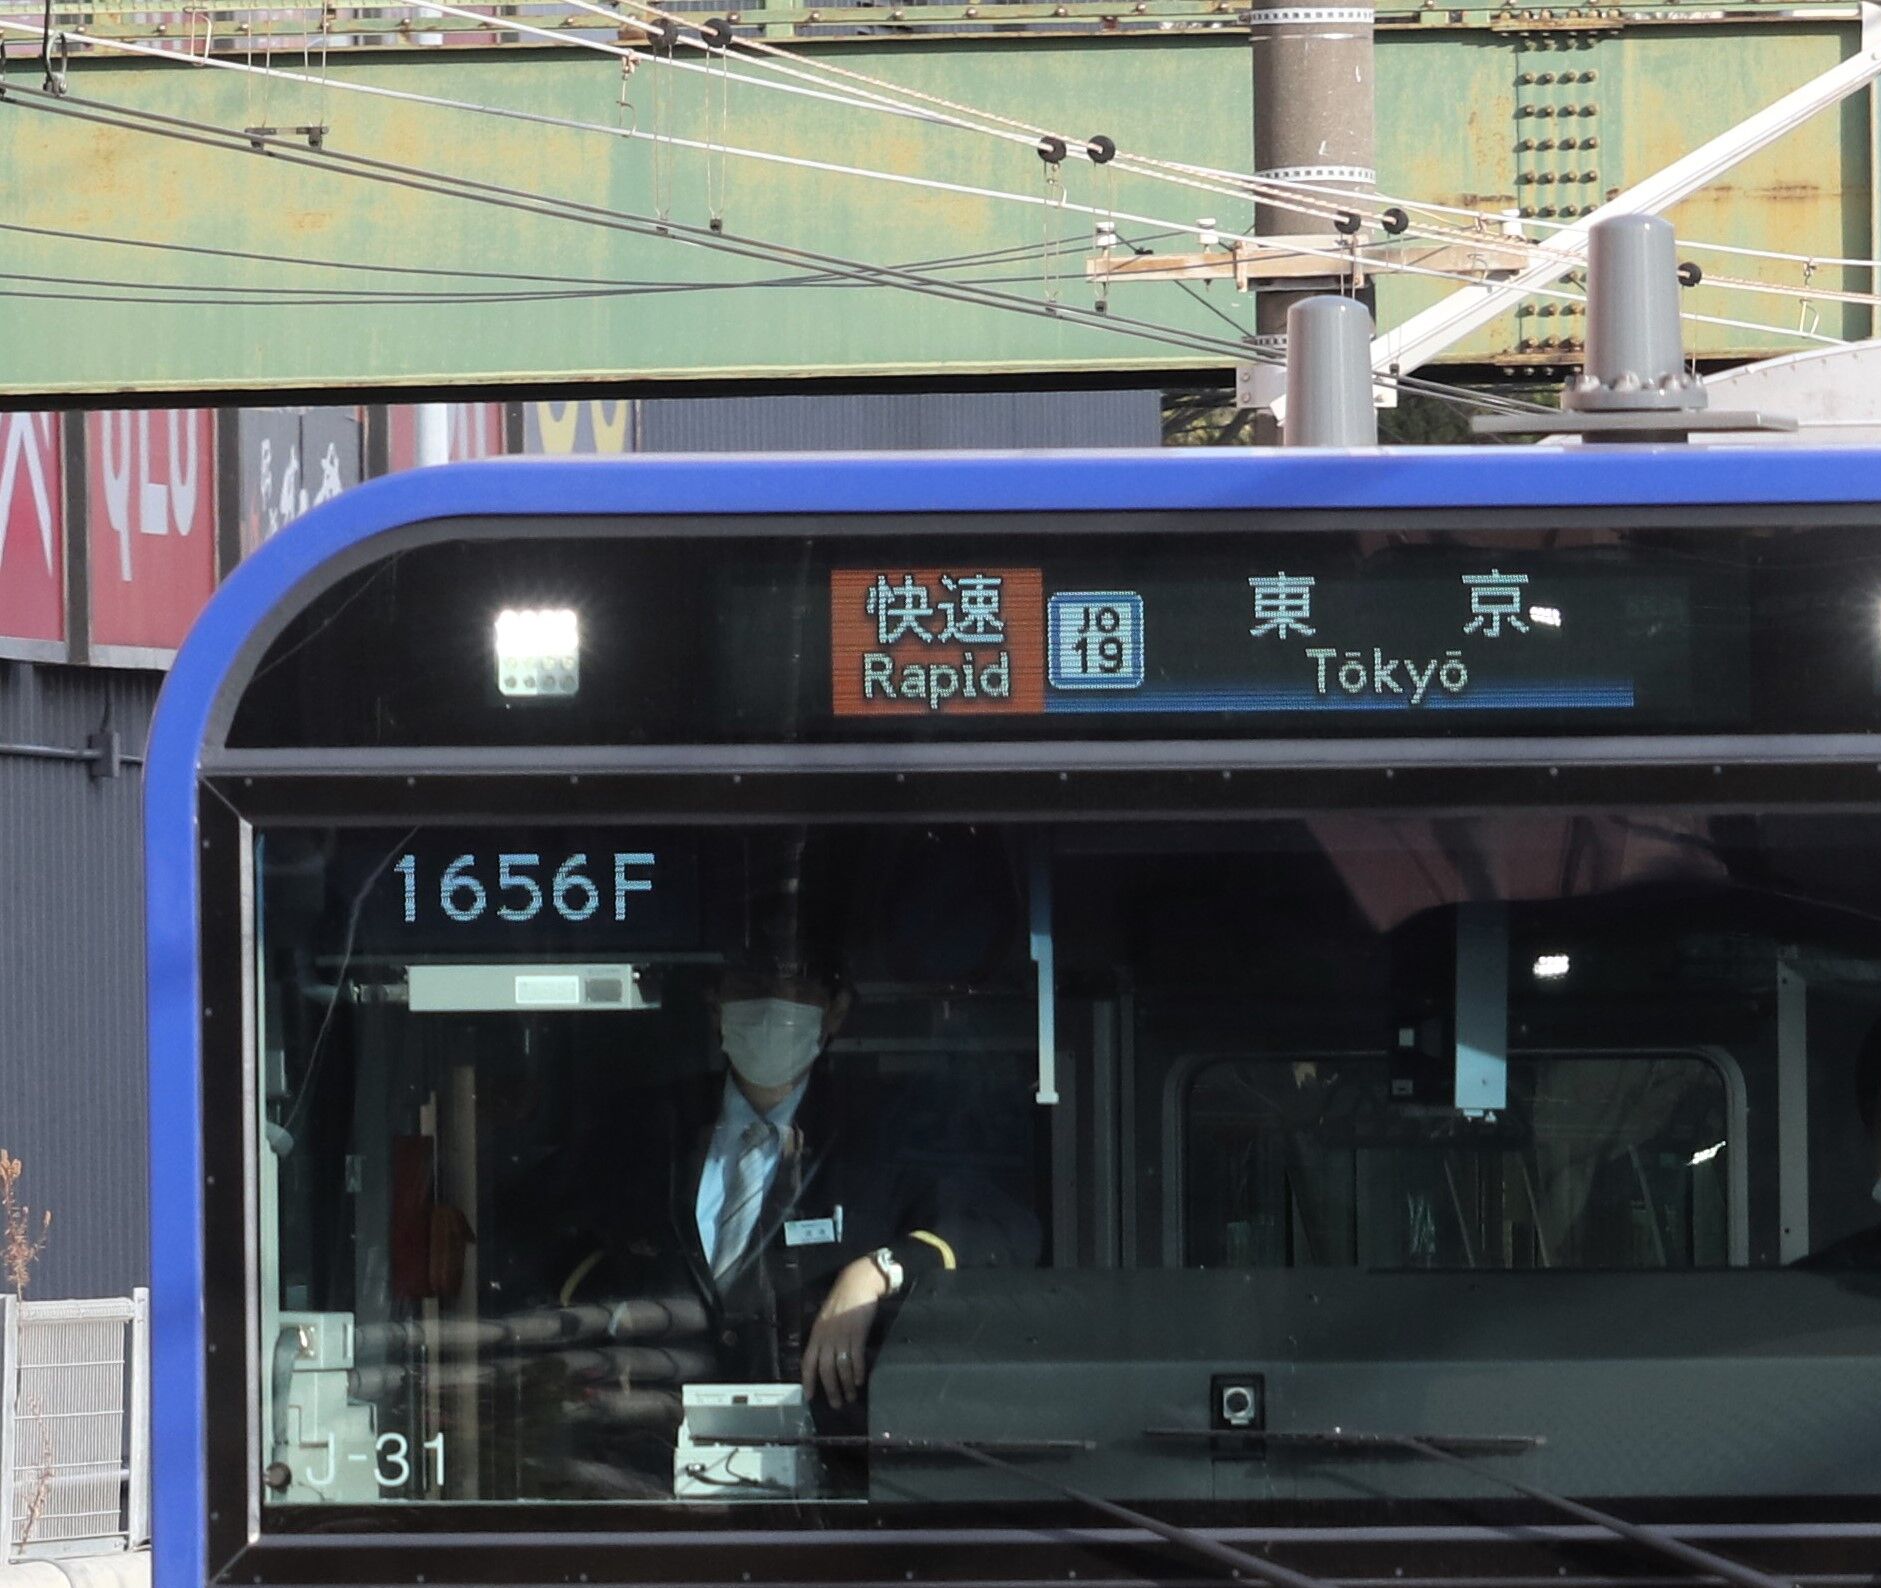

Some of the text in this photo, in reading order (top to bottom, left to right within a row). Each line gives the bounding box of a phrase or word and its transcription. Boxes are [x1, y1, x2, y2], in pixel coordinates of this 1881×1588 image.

[866, 574, 1005, 645] 快速
[1077, 606, 1121, 634] JO
[1247, 569, 1530, 640] 東京
[863, 652, 1010, 710] Rapid
[1071, 636, 1124, 674] 19
[1305, 647, 1470, 706] Tōkyō
[394, 852, 656, 922] 1656F
[304, 1431, 447, 1488] J-31
